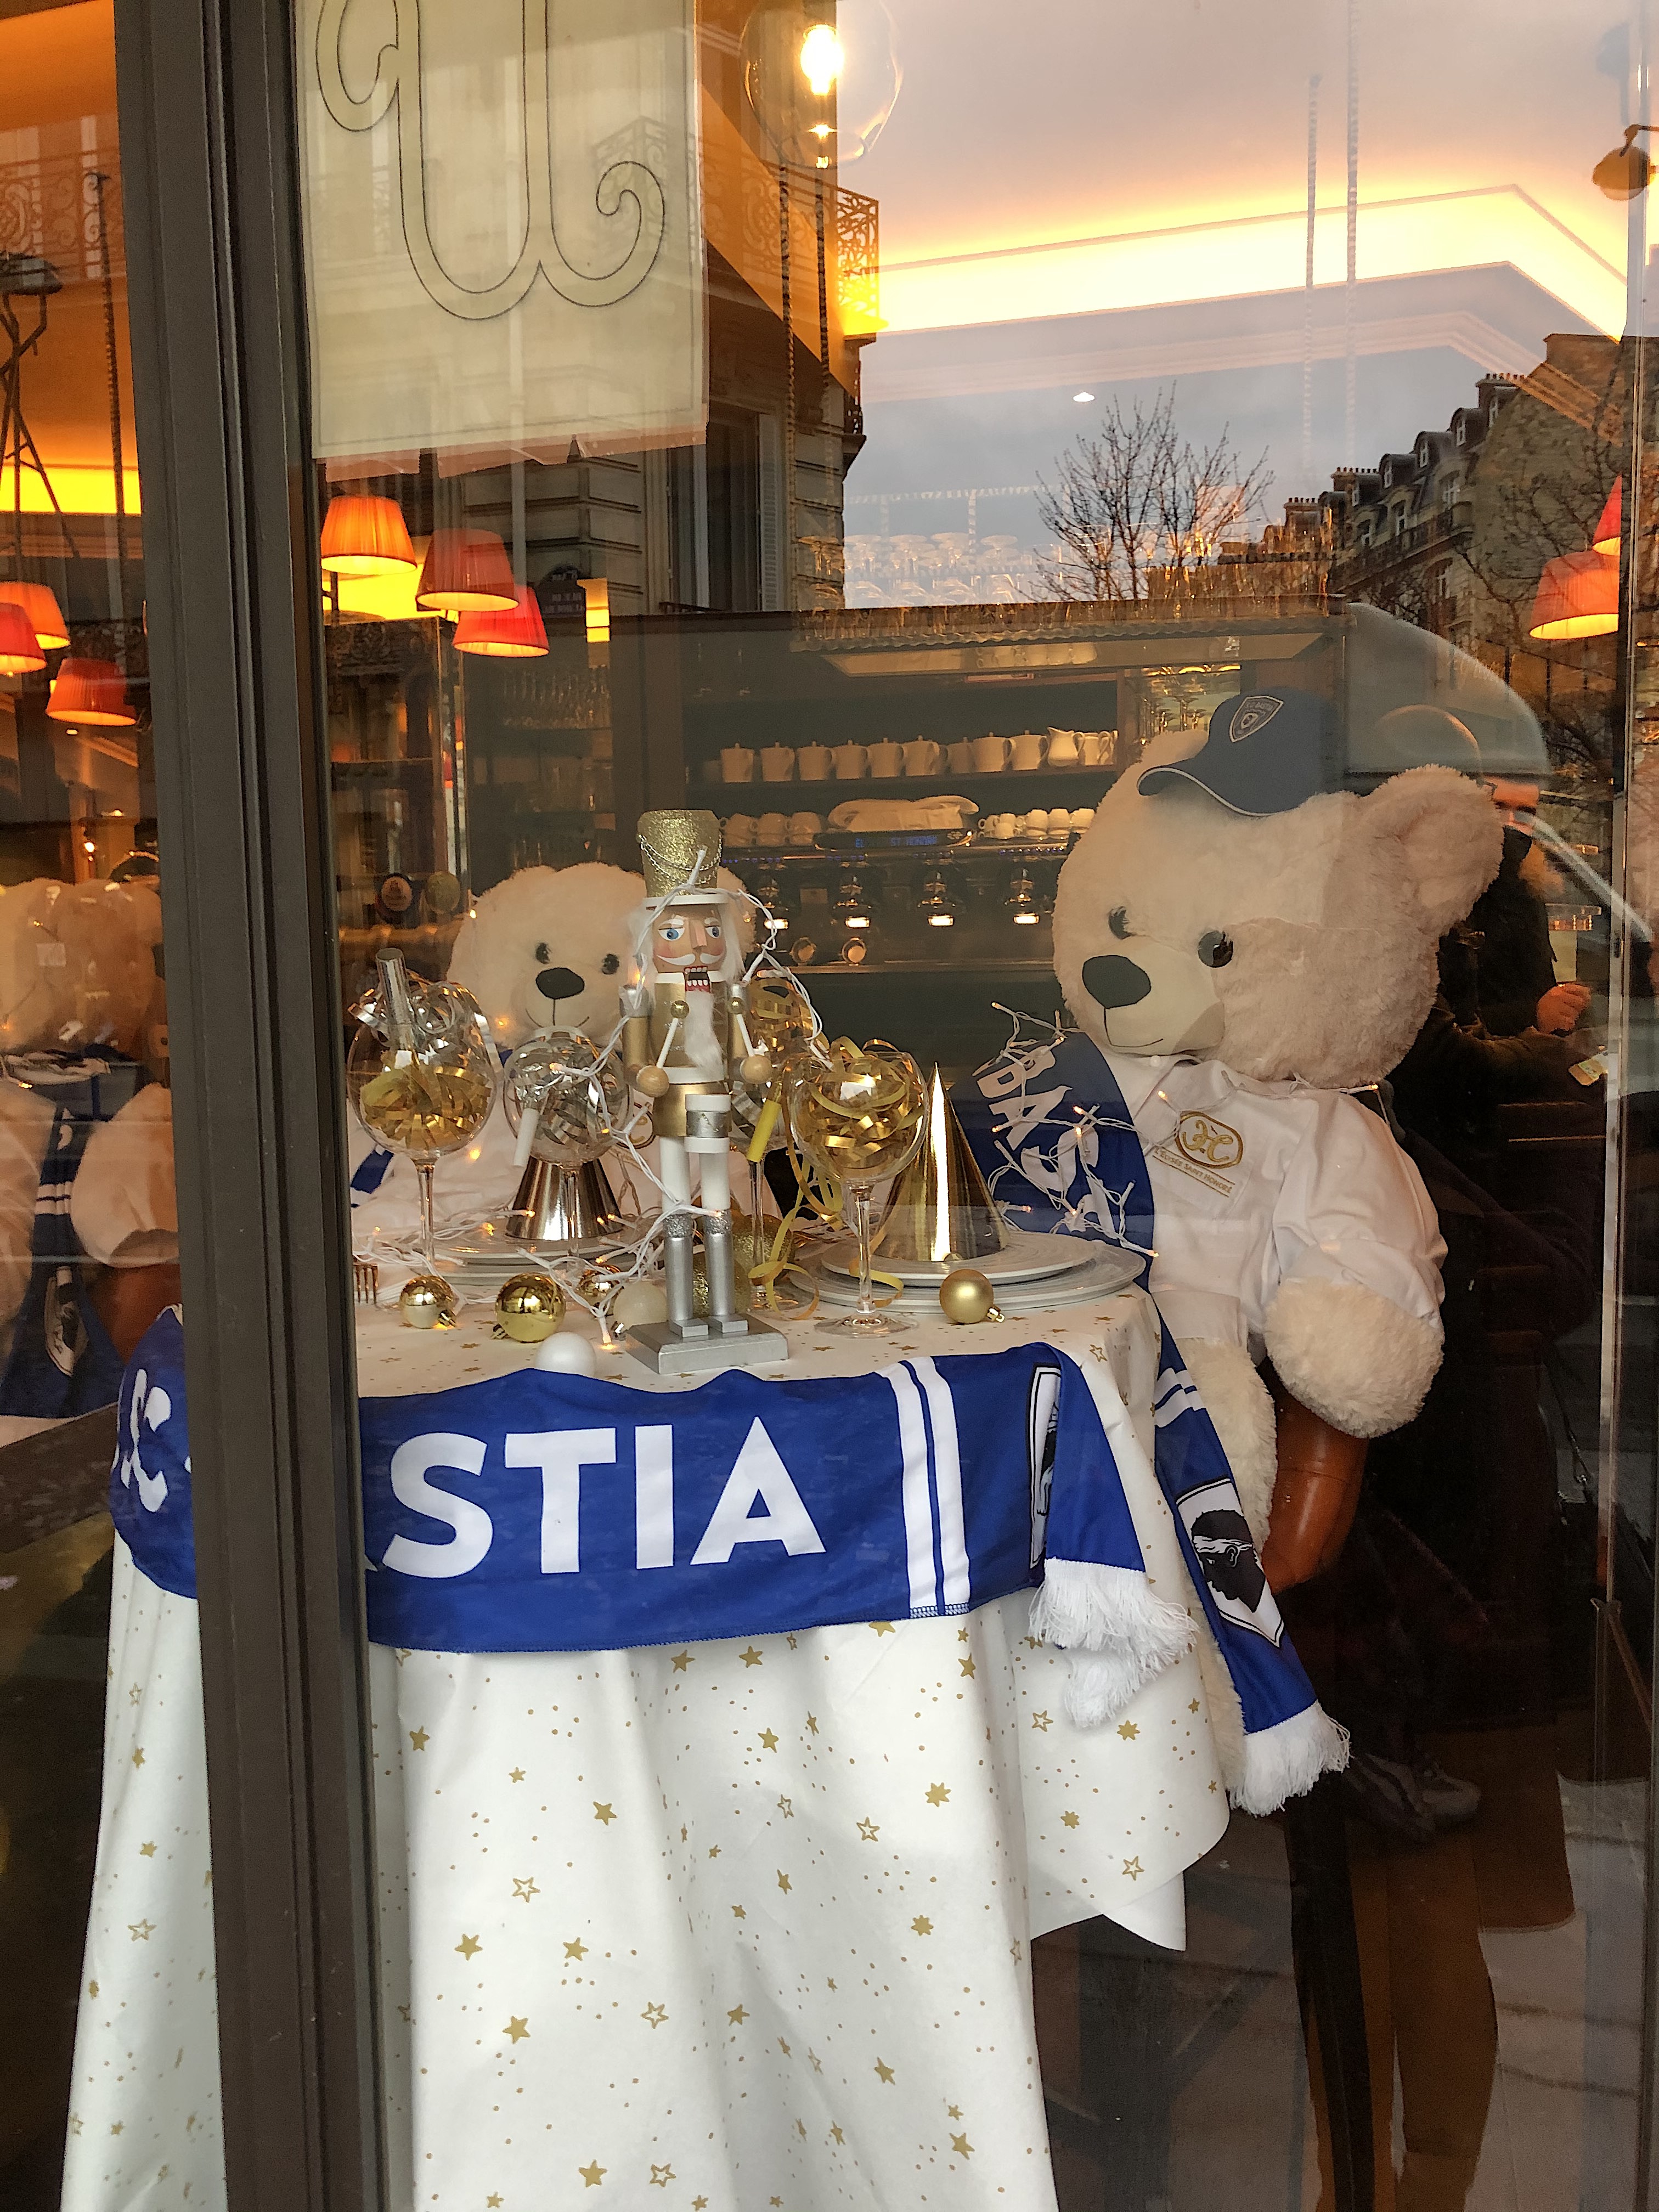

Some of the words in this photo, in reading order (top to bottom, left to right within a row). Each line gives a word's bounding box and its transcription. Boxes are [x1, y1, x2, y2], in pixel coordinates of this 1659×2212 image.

[1183, 1163, 1204, 1177] SAINT
[1205, 1173, 1233, 1194] HONORÉ
[364, 1416, 826, 1578] STIA
